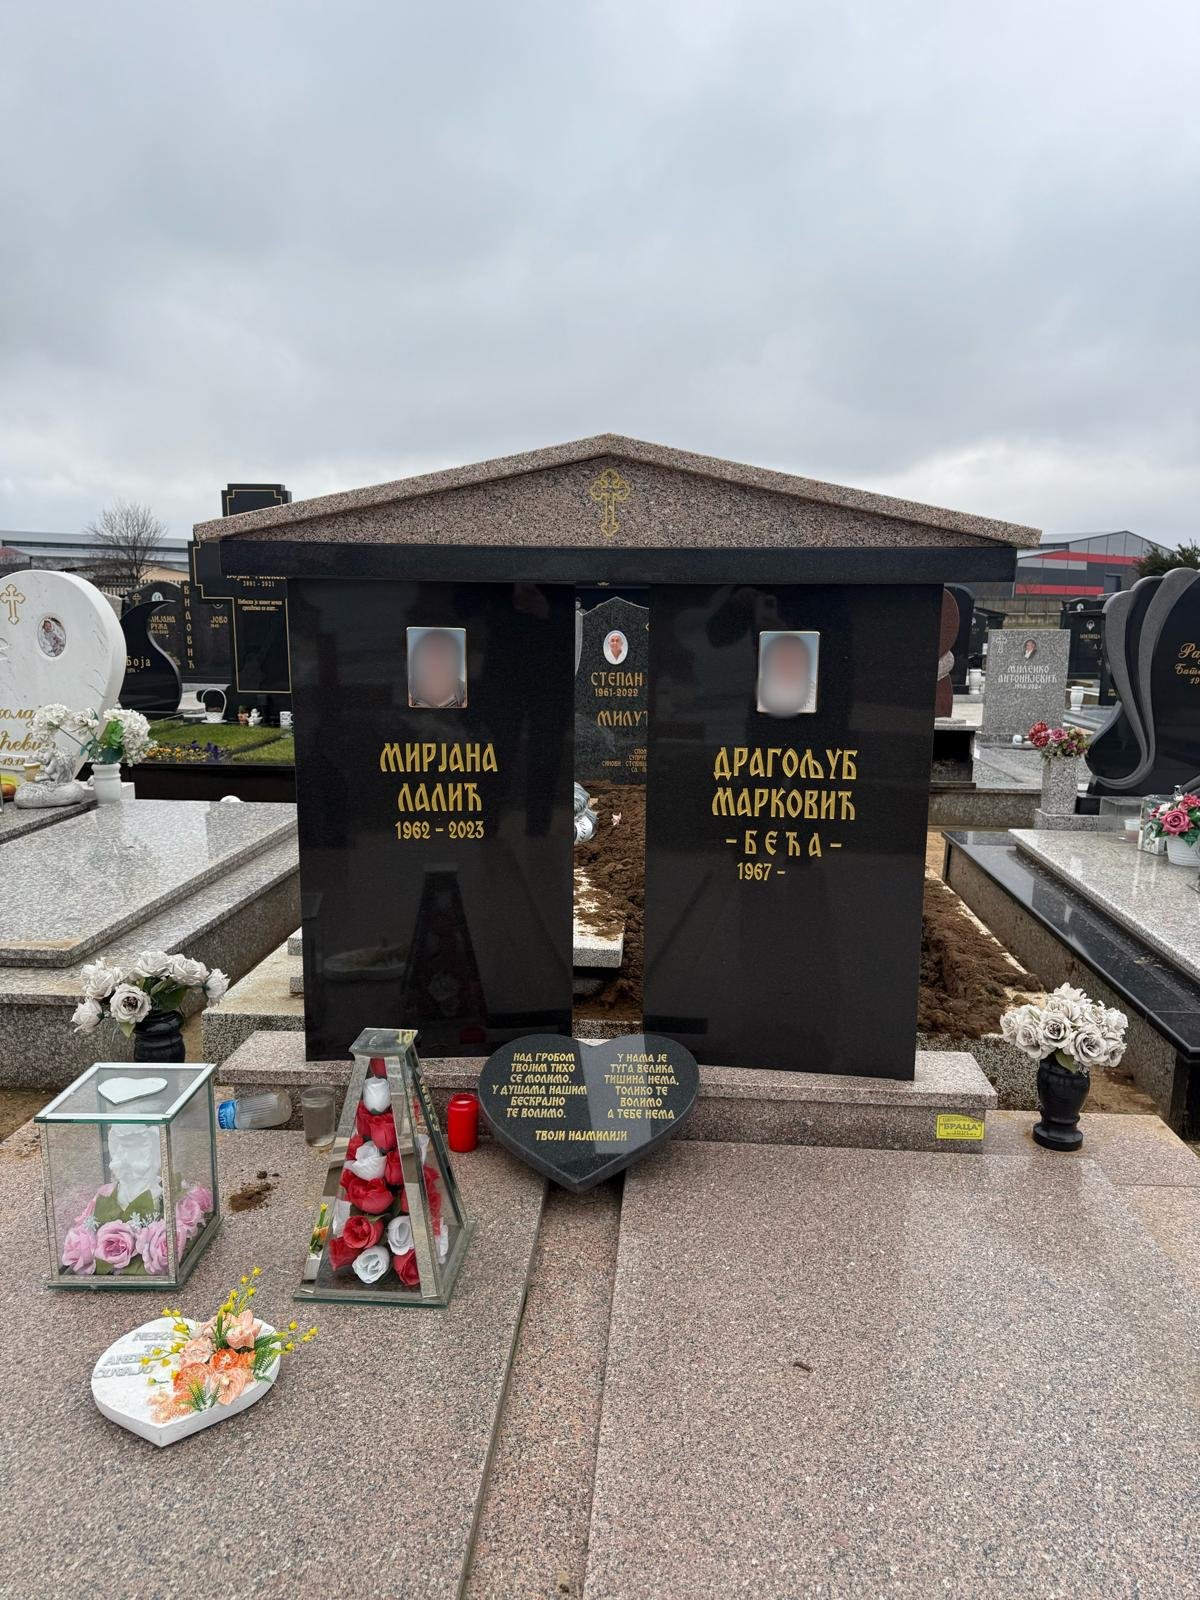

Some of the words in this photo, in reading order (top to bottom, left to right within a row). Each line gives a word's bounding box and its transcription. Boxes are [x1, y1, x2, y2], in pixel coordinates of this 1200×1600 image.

[1007, 664, 1050, 674] МИЛЕНКО
[591, 672, 643, 686] СТЕПАН
[997, 674, 1058, 683] АНТОНИЈЕВИЋ
[594, 688, 639, 697] 1961-2022
[380, 743, 498, 772] МИРЈАНА
[713, 747, 858, 781] ДРАГОЉУБ
[398, 783, 482, 811] ЛАЛИЋ
[712, 787, 855, 820] МАРКОВИЋ
[395, 821, 431, 839] 1962
[448, 821, 485, 839] 2023
[737, 862, 772, 880] 1967
[513, 1053, 533, 1062] НАД
[535, 1053, 575, 1062] ГРОБОМ
[617, 1053, 624, 1062] У
[626, 1053, 654, 1062] НАМА
[657, 1053, 667, 1062] ЈЕ
[511, 1063, 547, 1072] ТВОЈИМ
[551, 1063, 575, 1072] ТИХО
[610, 1064, 633, 1073] ТУГА
[637, 1064, 674, 1073] ВЕЛИКА
[510, 1074, 523, 1083] СЕ
[525, 1074, 572, 1083] МОЛИМО.
[604, 1074, 645, 1084] ТИШИНА
[648, 1075, 679, 1086] НЕМА,
[492, 1085, 499, 1094] У
[500, 1085, 546, 1095] ДУШАМА
[549, 1085, 587, 1095] НАШИМ
[615, 1086, 653, 1095] ТОЛИКО
[656, 1086, 668, 1095] ТЕ
[510, 1096, 566, 1106] БЕСКРАЈНО
[620, 1097, 663, 1107] ВОЛИМО
[506, 1108, 519, 1118] ТЕ
[521, 1108, 567, 1118] ВОЛИМО.
[607, 1109, 614, 1119] А
[617, 1109, 642, 1119] ТЕБЕ
[645, 1109, 675, 1119] НЕМА
[535, 1130, 565, 1141] ТВОЈИ
[568, 1130, 628, 1141] НАЈМИЛИЈИ
